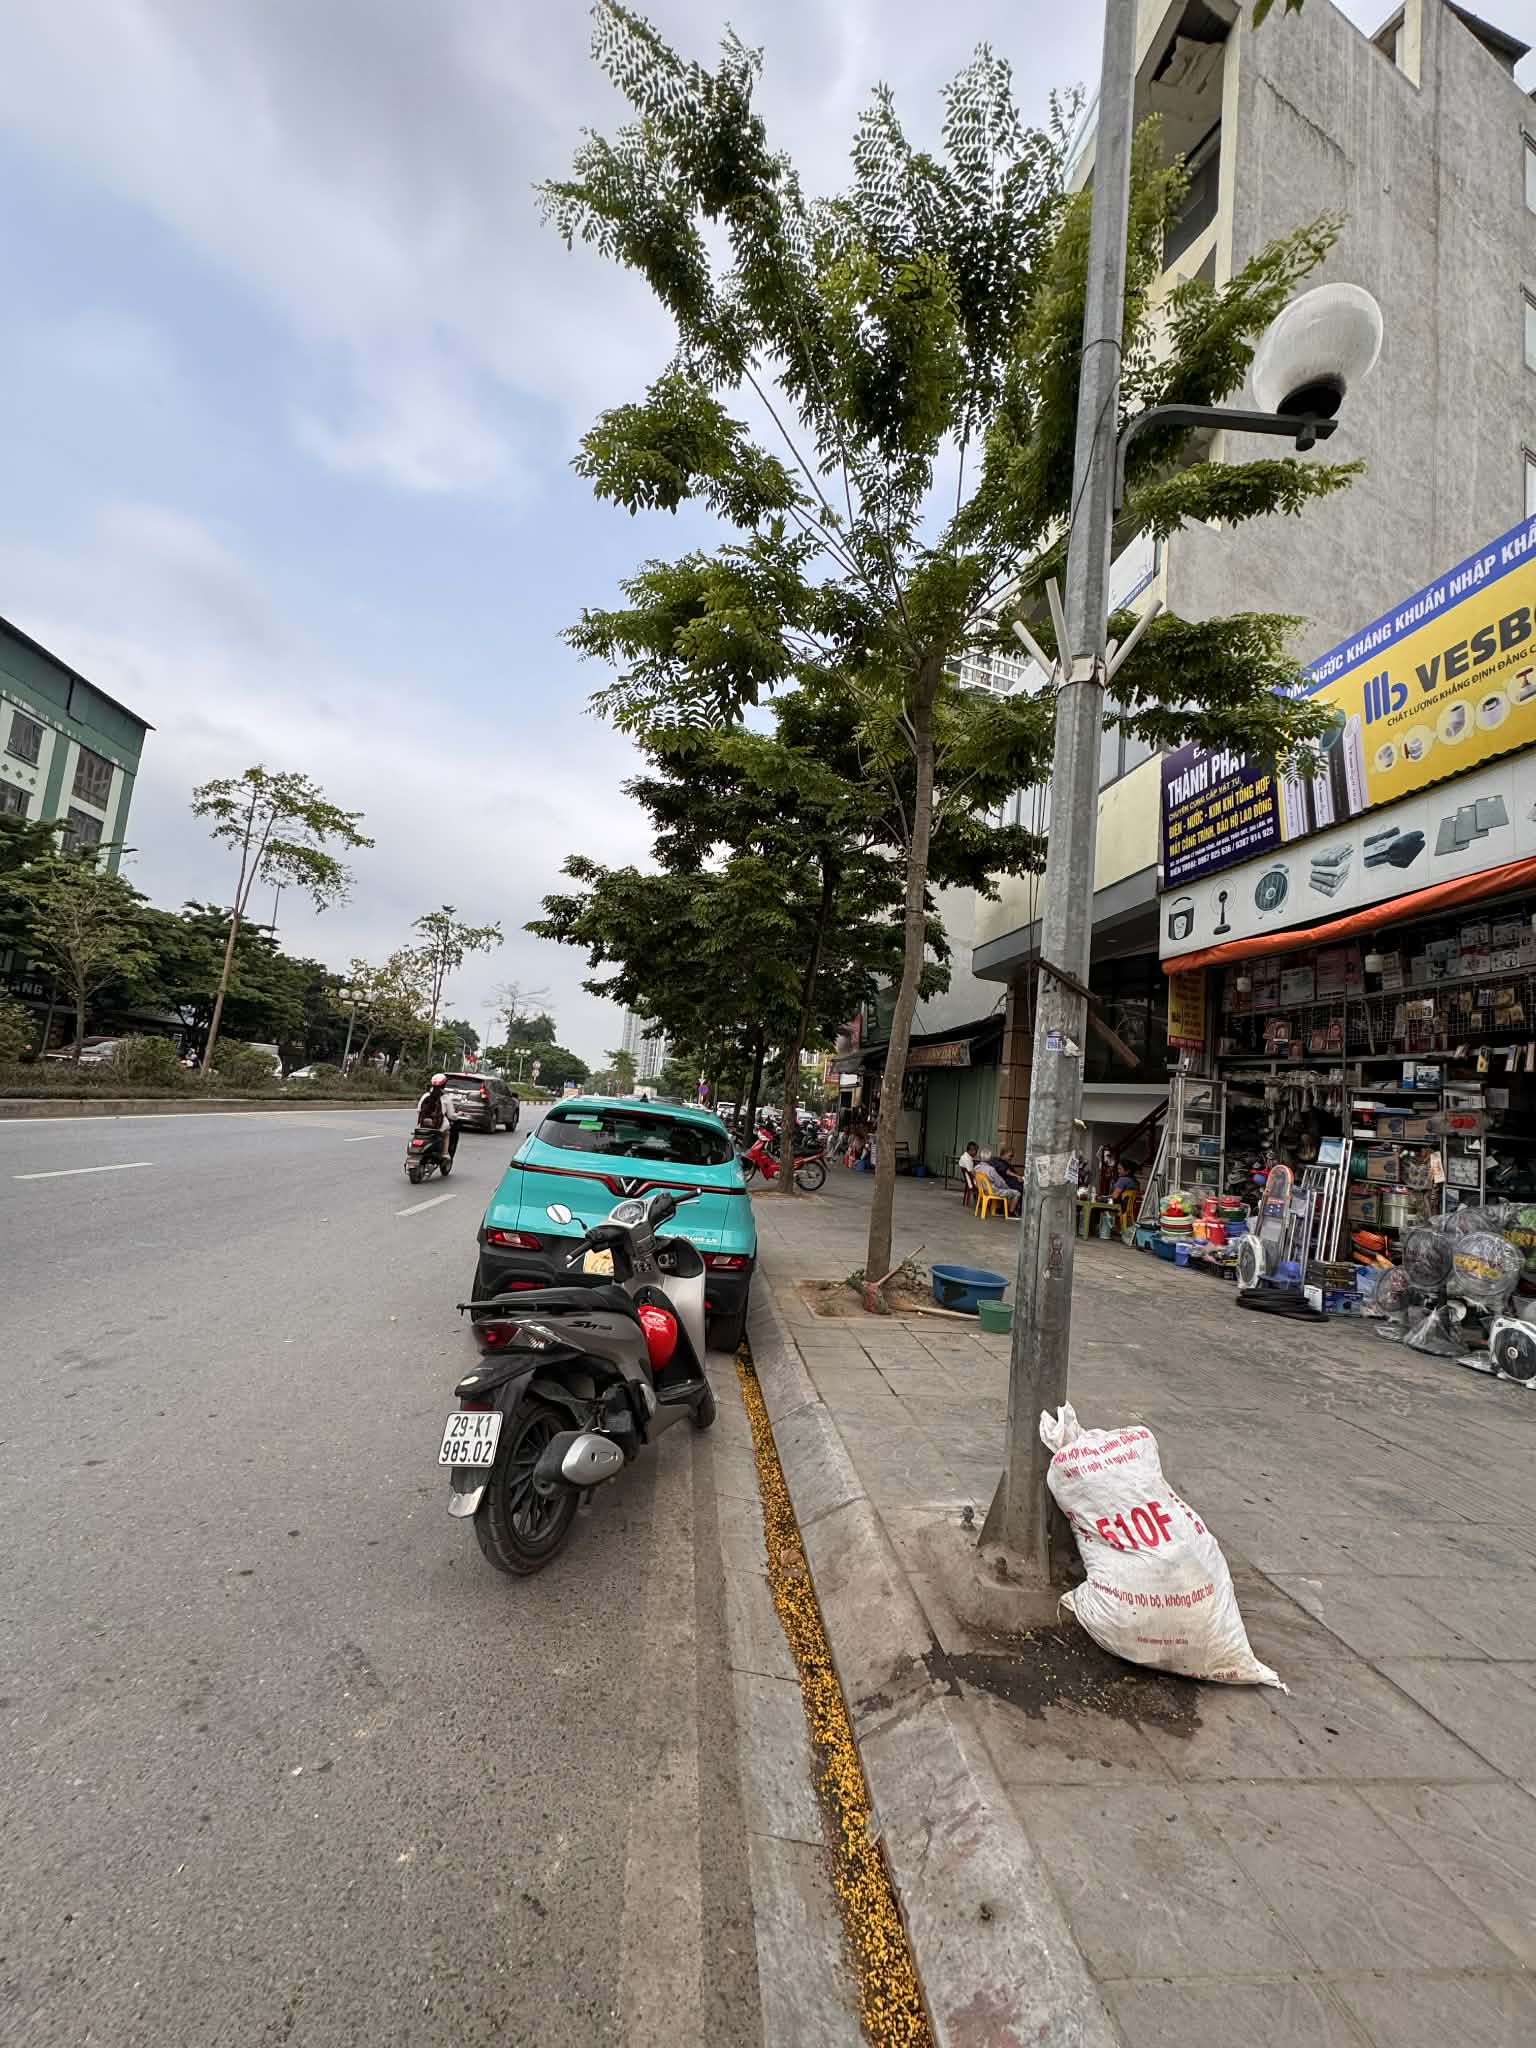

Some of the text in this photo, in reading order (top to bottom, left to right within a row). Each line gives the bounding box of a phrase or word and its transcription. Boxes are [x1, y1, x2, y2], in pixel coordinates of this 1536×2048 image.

[1346, 622, 1392, 665] KHÁNG
[1395, 587, 1447, 634] KHUẨN
[1449, 554, 1497, 599] NHẬP
[1415, 606, 1536, 694] VESB
[1409, 695, 1439, 716] LƯỢNG
[1471, 666, 1497, 685] ĐỊNH
[1168, 760, 1208, 808] THÀNH
[1181, 833, 1197, 852] CÔNG
[1239, 806, 1253, 824] LAO
[1253, 797, 1273, 818] ĐỘNG
[1208, 800, 1222, 819] KIM
[450, 1415, 492, 1438] 29-K1
[441, 1440, 493, 1463] 985.02
[1095, 1501, 1173, 1552] 510F
[1134, 1592, 1149, 1607] nội
[1149, 1592, 1164, 1608] bộ,
[1164, 1593, 1191, 1608] không
[1190, 1587, 1206, 1603] được
